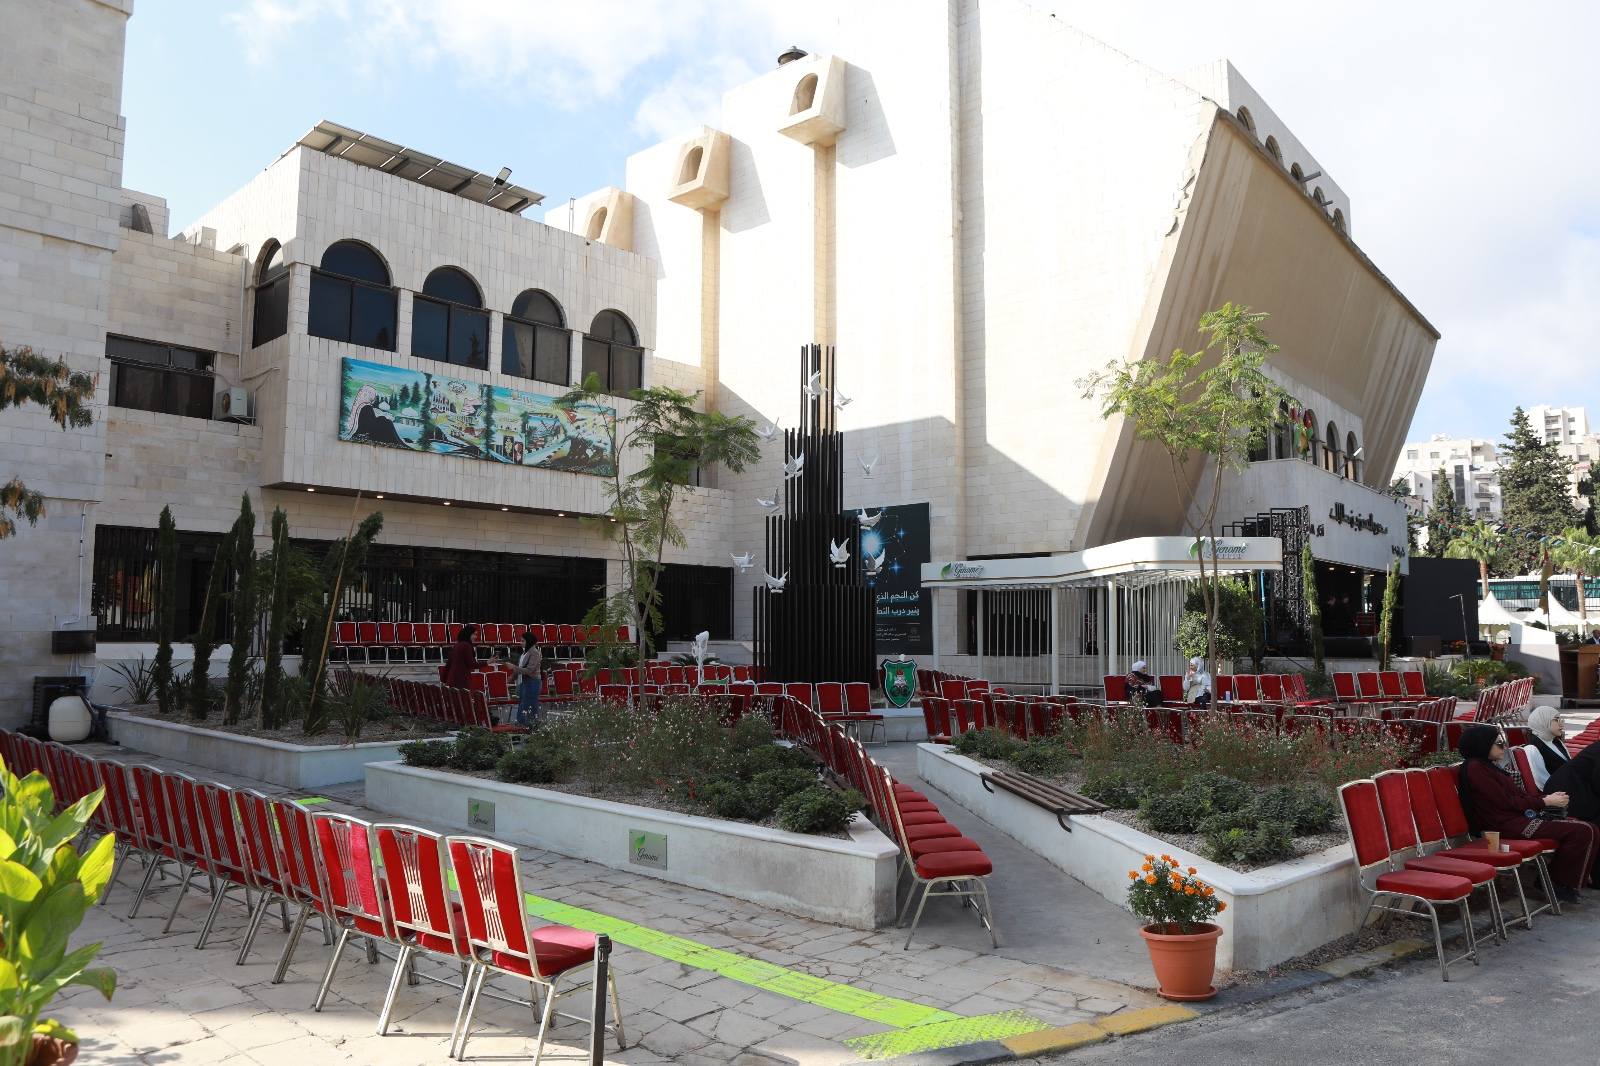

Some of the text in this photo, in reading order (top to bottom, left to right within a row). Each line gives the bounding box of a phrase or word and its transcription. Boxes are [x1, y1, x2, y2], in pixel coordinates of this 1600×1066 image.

[890, 590, 908, 603] النجم
[909, 590, 920, 600] كن
[891, 607, 906, 616] درب
[906, 606, 920, 616] ينير
